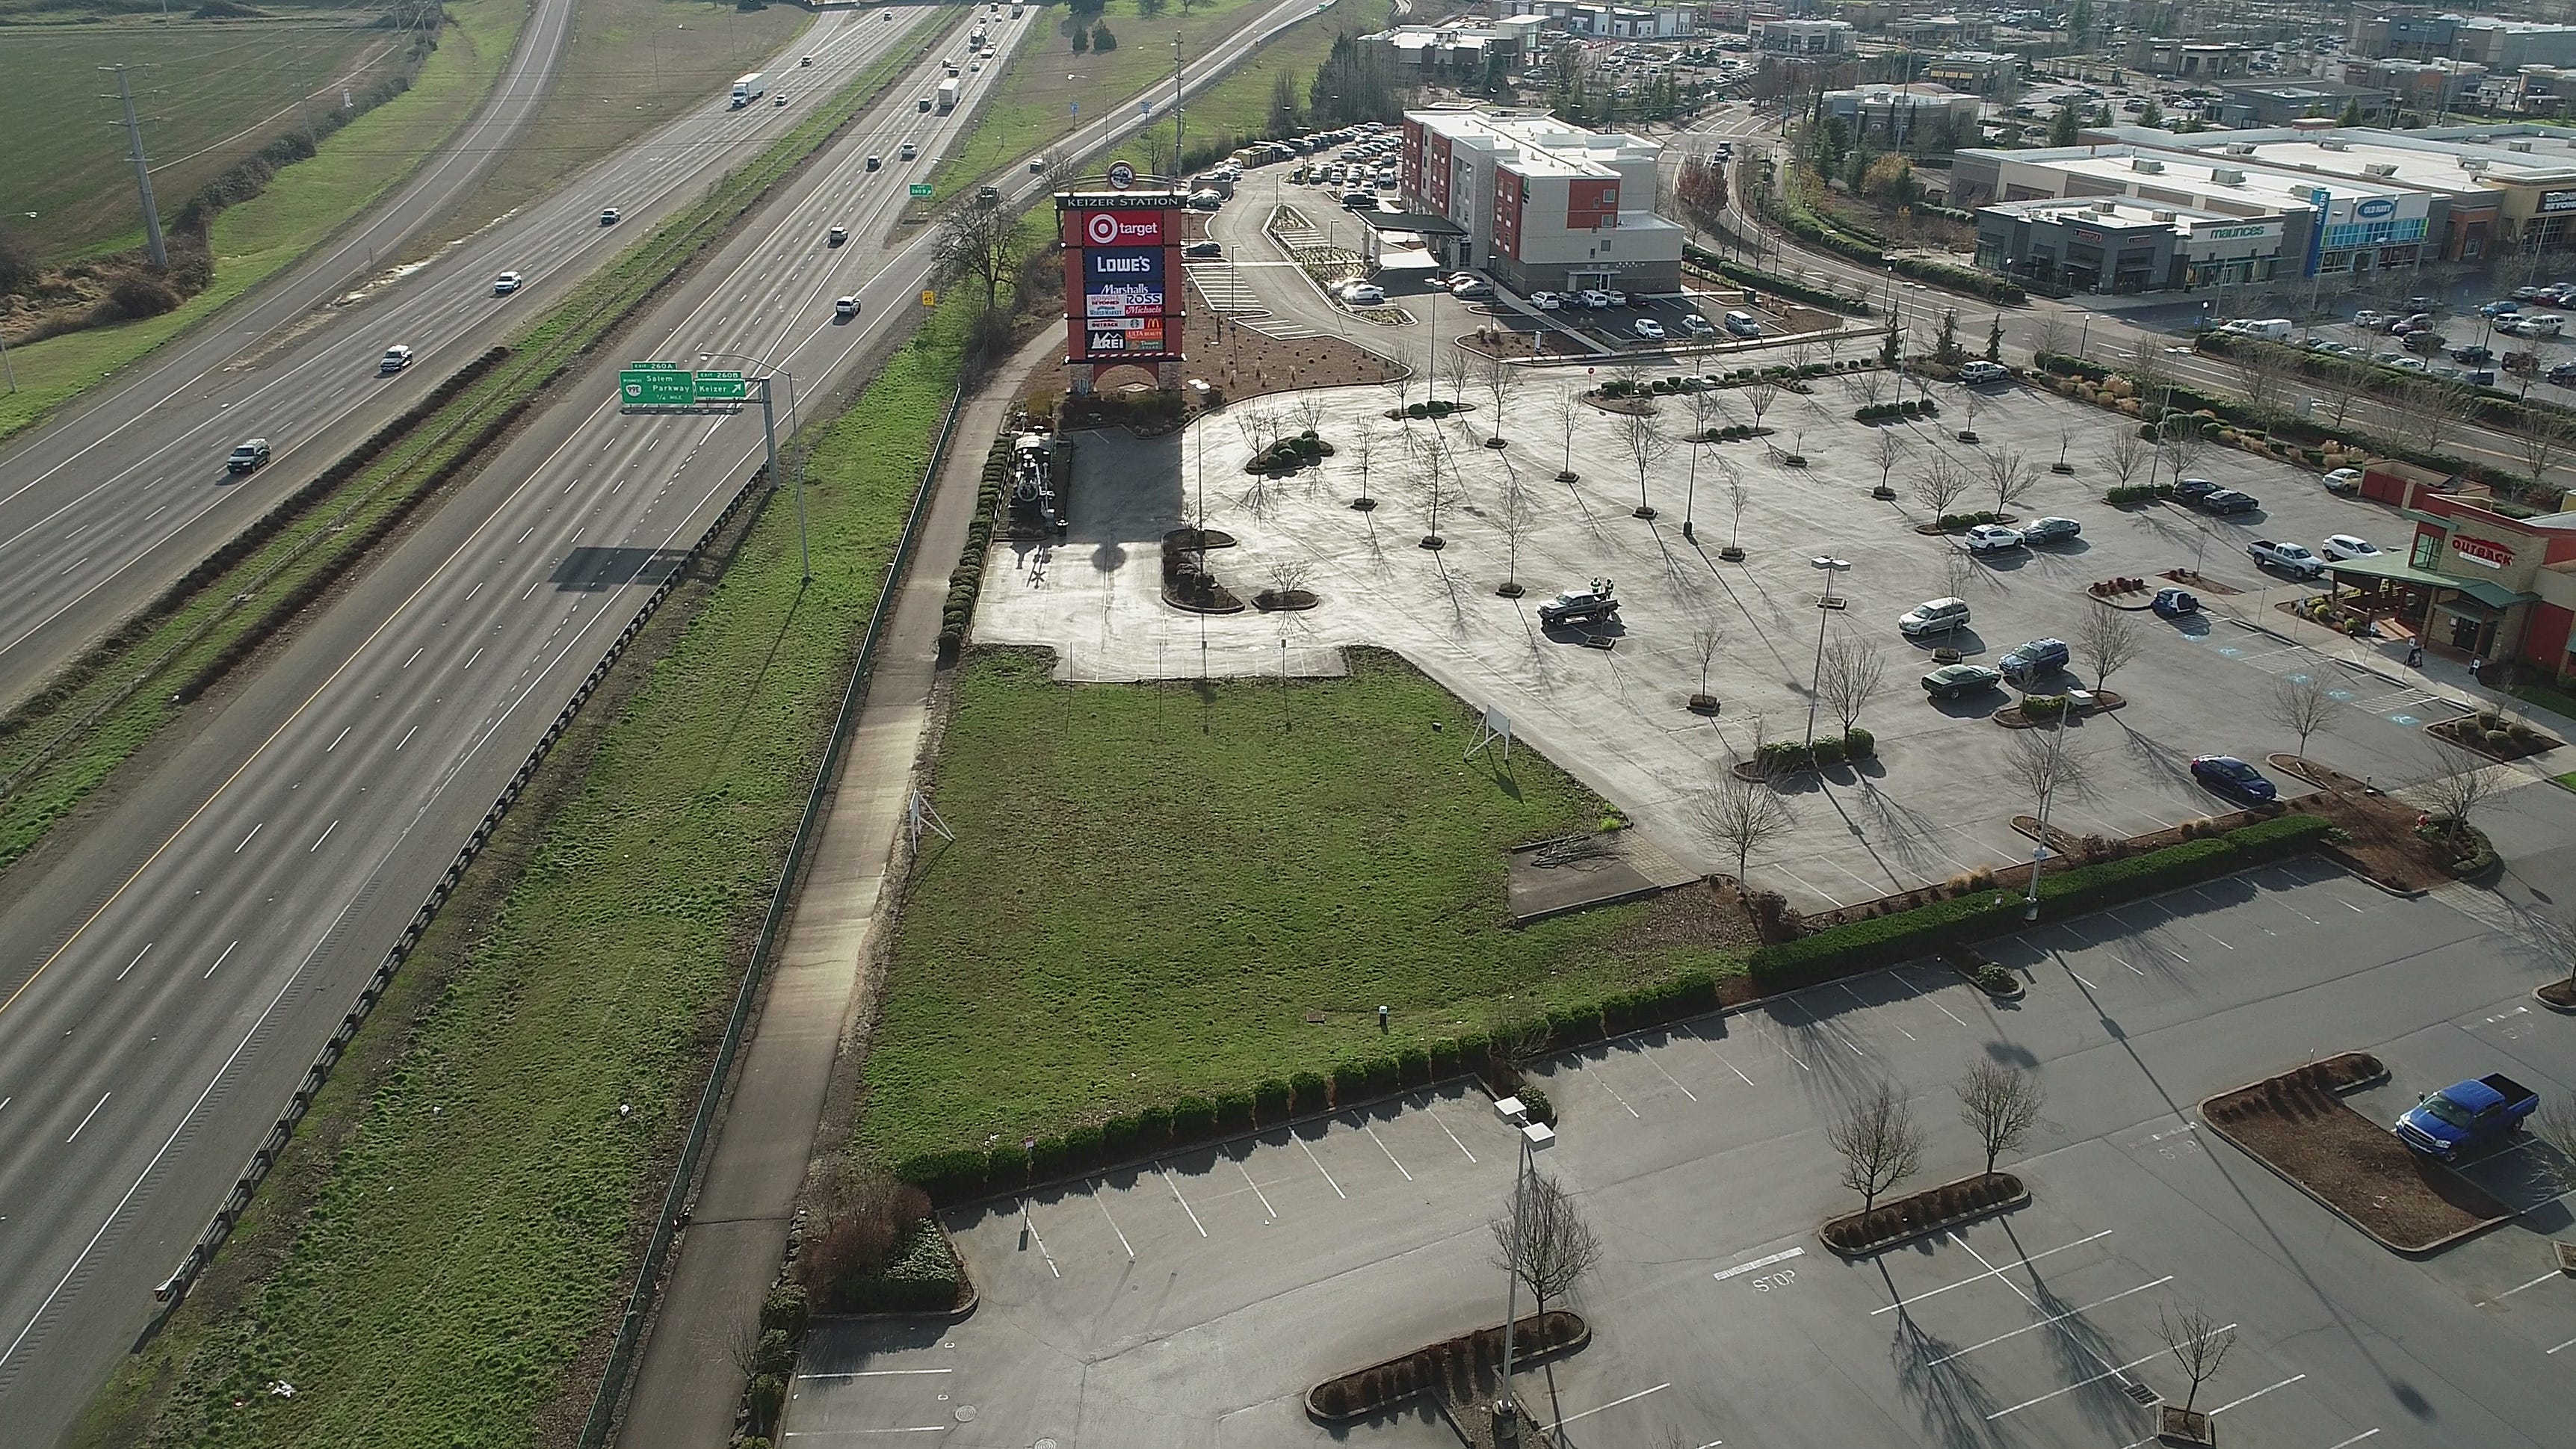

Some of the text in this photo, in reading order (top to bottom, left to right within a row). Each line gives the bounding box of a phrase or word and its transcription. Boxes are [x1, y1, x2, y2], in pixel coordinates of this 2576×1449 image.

[1067, 197, 1178, 207] KEIZER STATION
[2364, 206, 2376, 214] OLD
[1119, 222, 1158, 236] target
[1097, 256, 1151, 273] LOWE'S
[1100, 283, 1149, 294] Marshalls
[1126, 294, 1161, 304] ROSS
[1125, 305, 1162, 315] Michaels
[1104, 339, 1124, 349] REI
[652, 384, 690, 393] Parkway
[2452, 538, 2514, 566] OUTBACK
[1752, 1270, 1795, 1292] STOP
